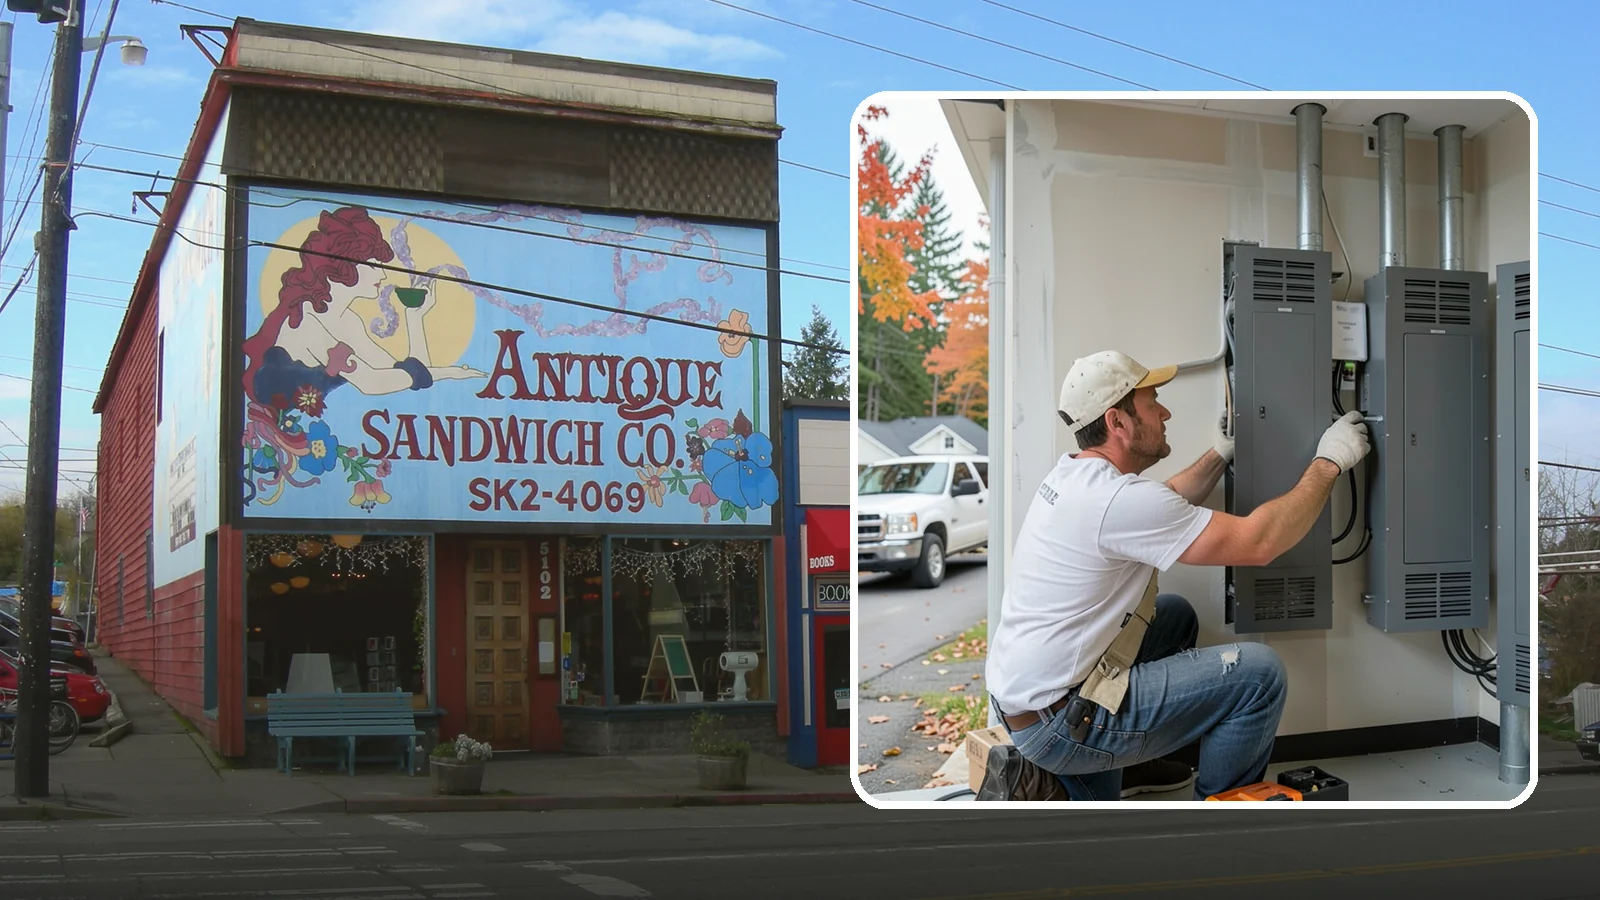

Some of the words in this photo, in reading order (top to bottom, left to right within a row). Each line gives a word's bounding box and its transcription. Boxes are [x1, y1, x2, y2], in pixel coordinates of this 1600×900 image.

[476, 329, 723, 421] ANTIQUE
[361, 408, 605, 467] SANDWICH
[617, 422, 685, 468] CO.
[468, 477, 646, 513] SK2-4069
[540, 541, 552, 600] 5102
[809, 555, 835, 569] BOOKS
